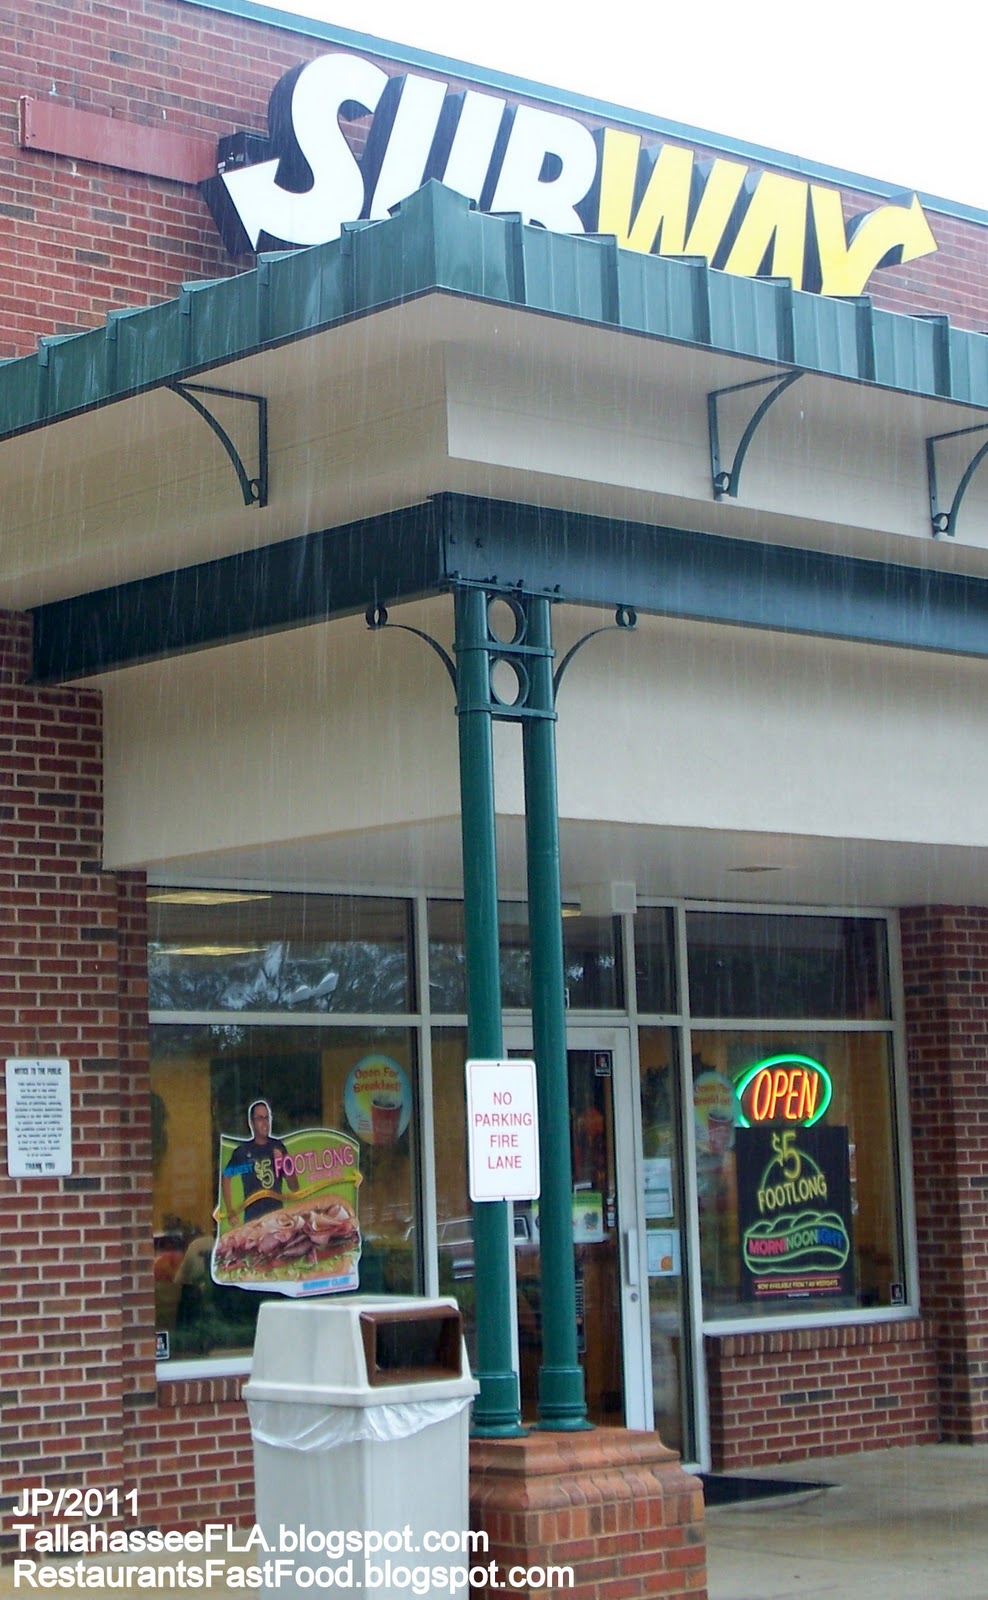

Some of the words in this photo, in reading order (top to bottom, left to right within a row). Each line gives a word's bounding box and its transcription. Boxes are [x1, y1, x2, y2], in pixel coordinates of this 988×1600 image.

[222, 53, 938, 298] SUBWAY
[493, 1092, 512, 1105] NO
[752, 1069, 818, 1120] OPEN
[475, 1113, 532, 1127] PARKING
[490, 1134, 518, 1148] FIRE
[771, 1130, 801, 1180] $5
[254, 1159, 274, 1189] $5
[274, 1146, 354, 1178] FOOTLONG
[488, 1156, 522, 1169] LANE
[758, 1174, 827, 1212] FOOTLONG
